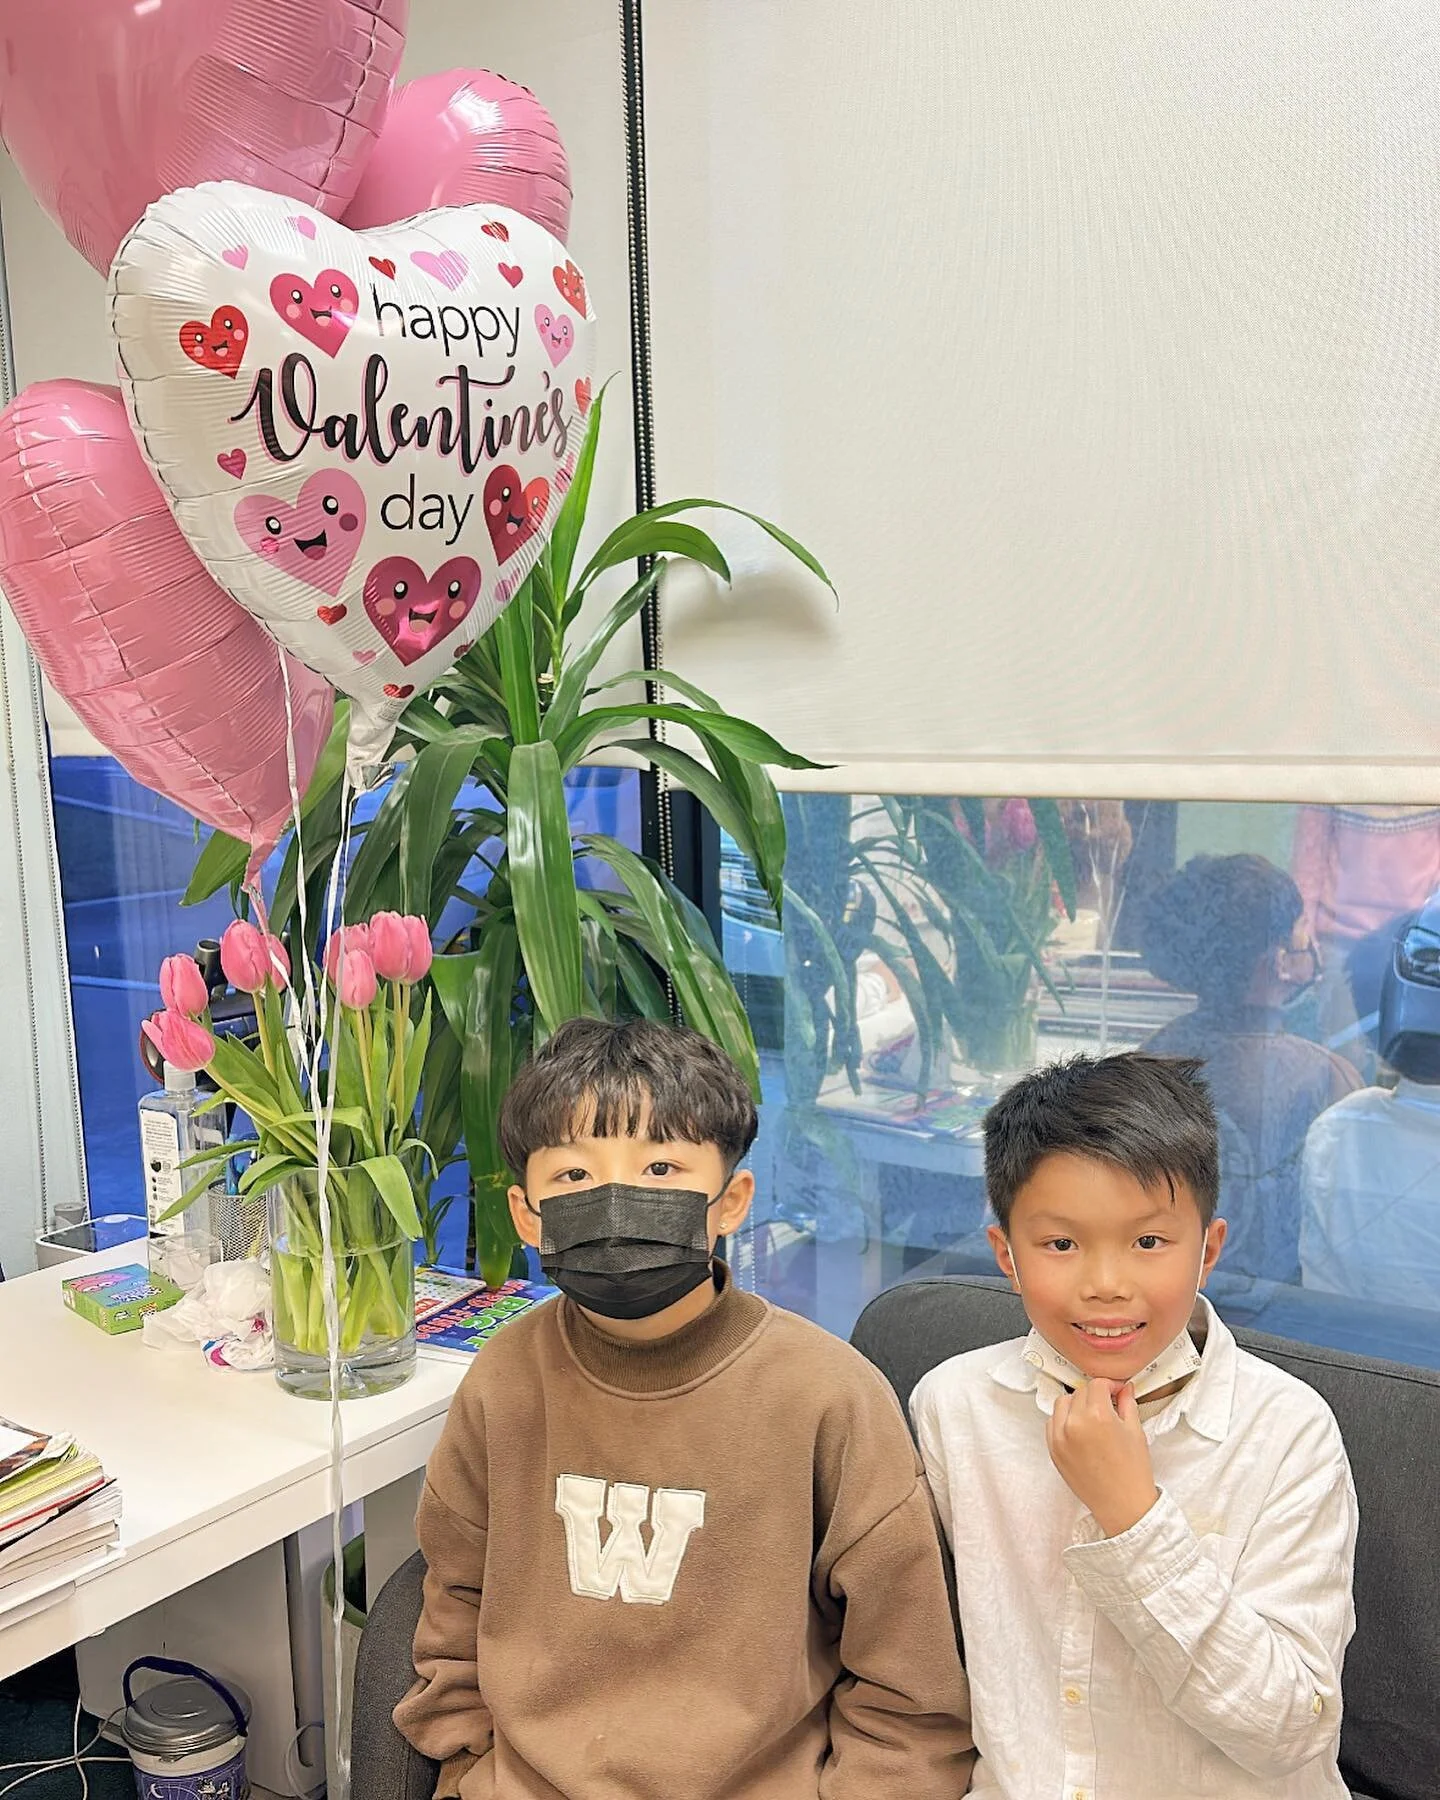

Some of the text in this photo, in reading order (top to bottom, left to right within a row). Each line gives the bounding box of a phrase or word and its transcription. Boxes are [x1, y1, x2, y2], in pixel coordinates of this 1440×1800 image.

[370, 283, 521, 357] happy
[228, 353, 573, 475] Valentine's
[380, 474, 475, 545] day
[555, 1473, 706, 1606] W
